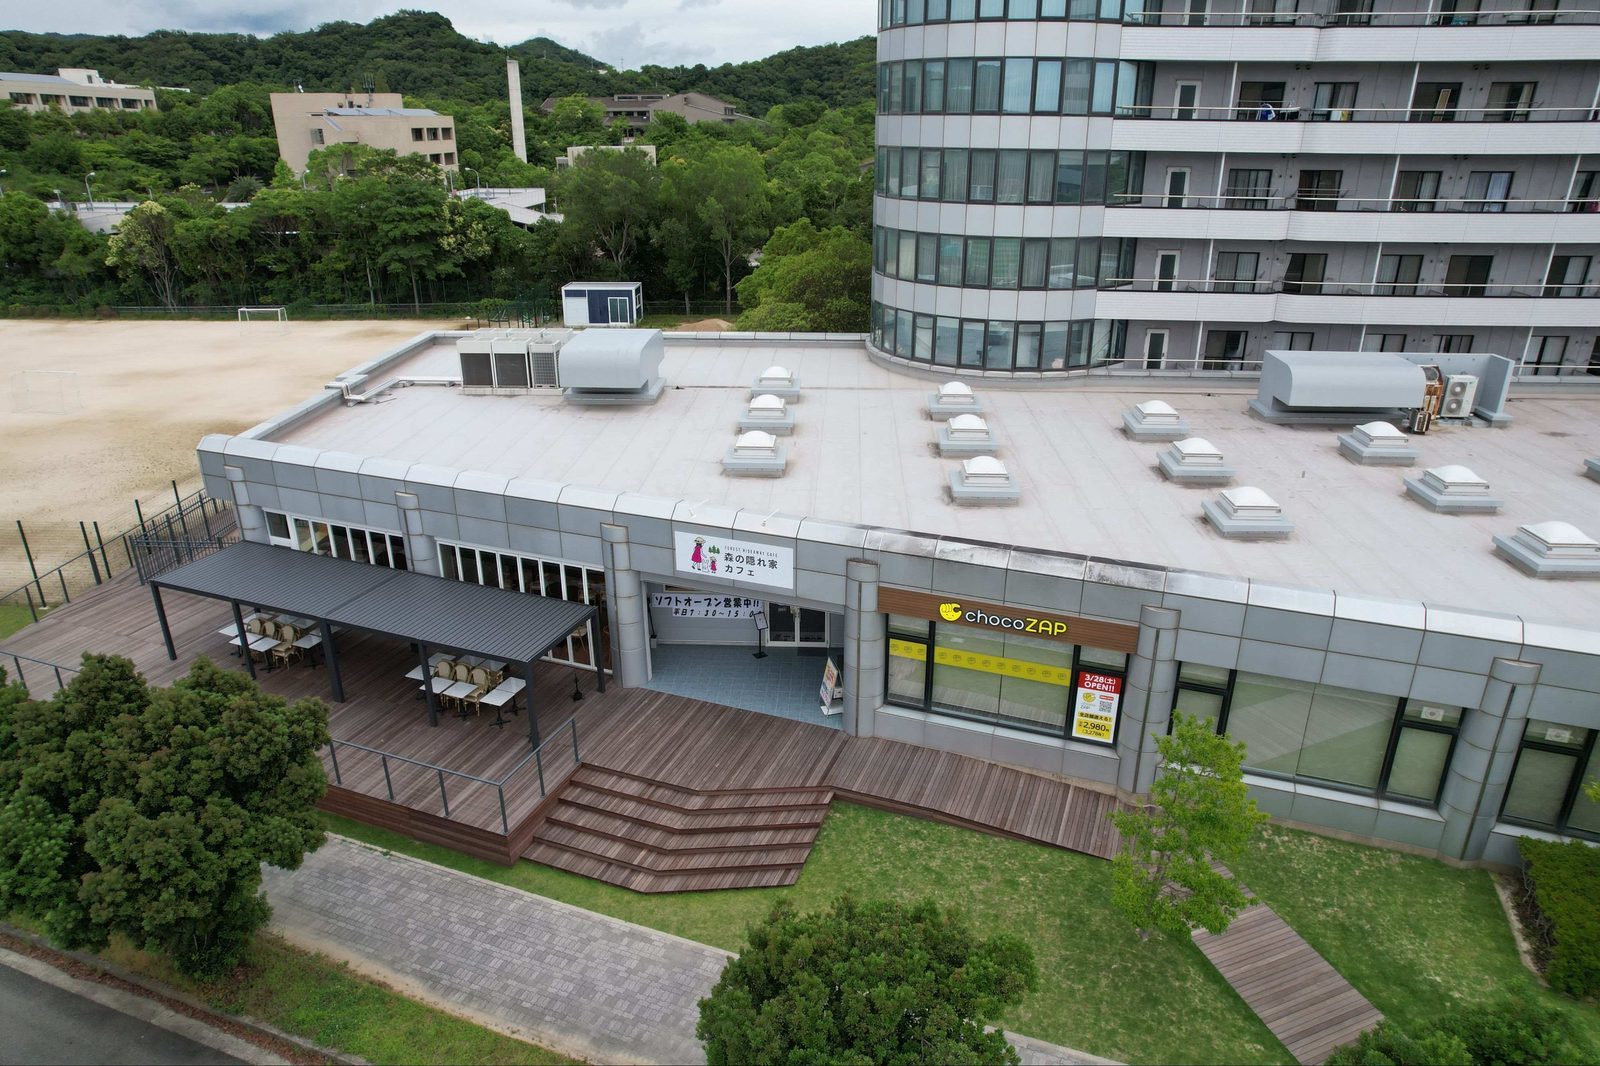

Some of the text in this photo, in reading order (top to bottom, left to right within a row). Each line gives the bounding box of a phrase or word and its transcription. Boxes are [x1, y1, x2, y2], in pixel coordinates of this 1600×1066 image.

[724, 552, 778, 569] 森の隠れ家
[725, 564, 755, 577] カフェ
[965, 608, 1068, 636] chocoZAP
[1084, 674, 1116, 685] 3/28(土)
[1084, 681, 1115, 692] OPEN!!
